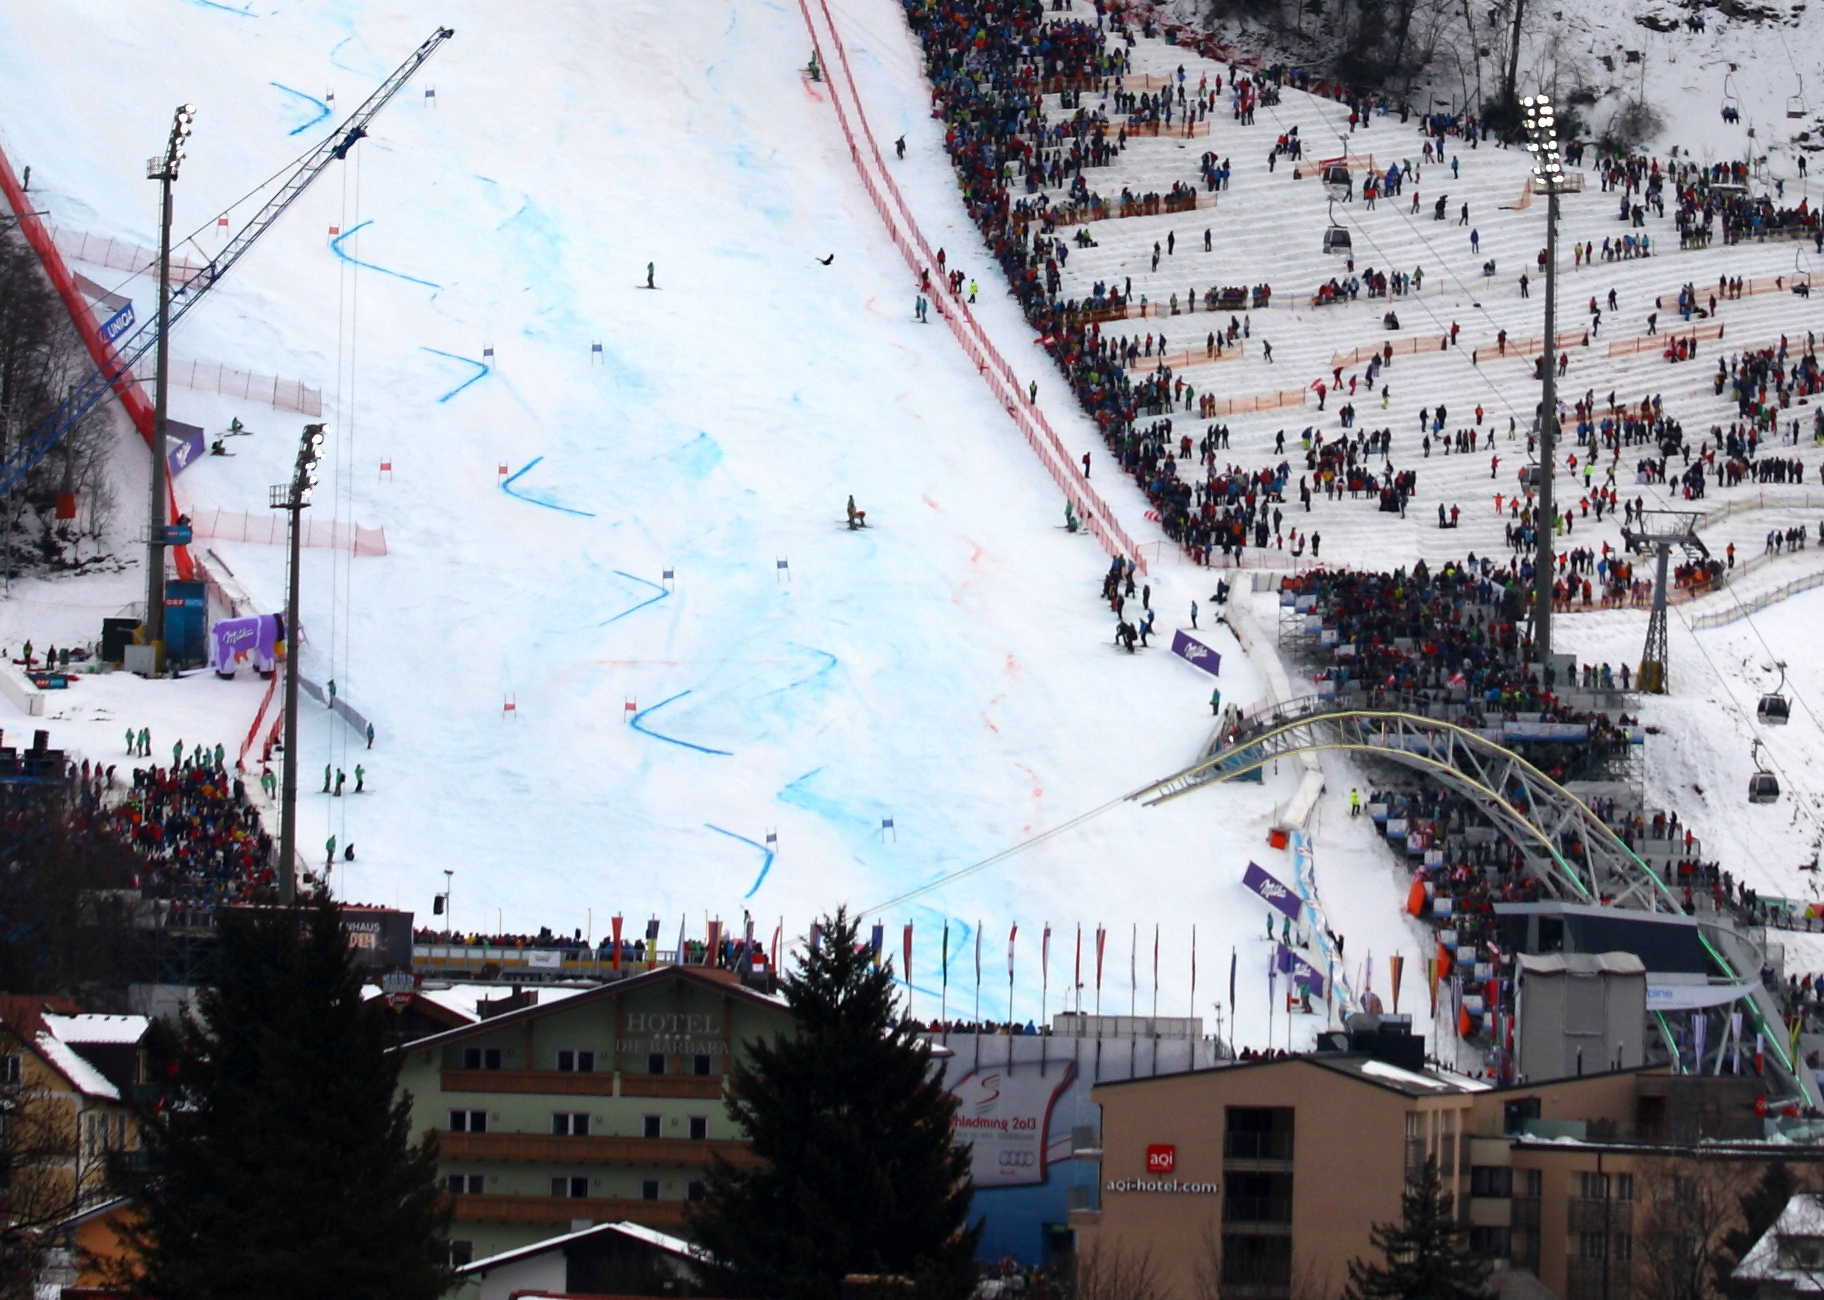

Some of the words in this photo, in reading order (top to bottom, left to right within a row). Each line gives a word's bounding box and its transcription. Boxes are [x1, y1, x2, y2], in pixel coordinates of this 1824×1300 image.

[222, 628, 255, 645] Milka
[1184, 642, 1207, 660] Milka
[1260, 879, 1286, 899] Milka
[626, 1011, 720, 1034] HOTEL
[615, 1040, 645, 1053] DIE
[650, 1040, 729, 1055] BARBARA
[954, 1115, 1008, 1132] hladming
[1012, 1116, 1037, 1130] 2013
[1150, 1151, 1173, 1167] aqi
[1106, 1178, 1218, 1194] aqi-hotel.com
